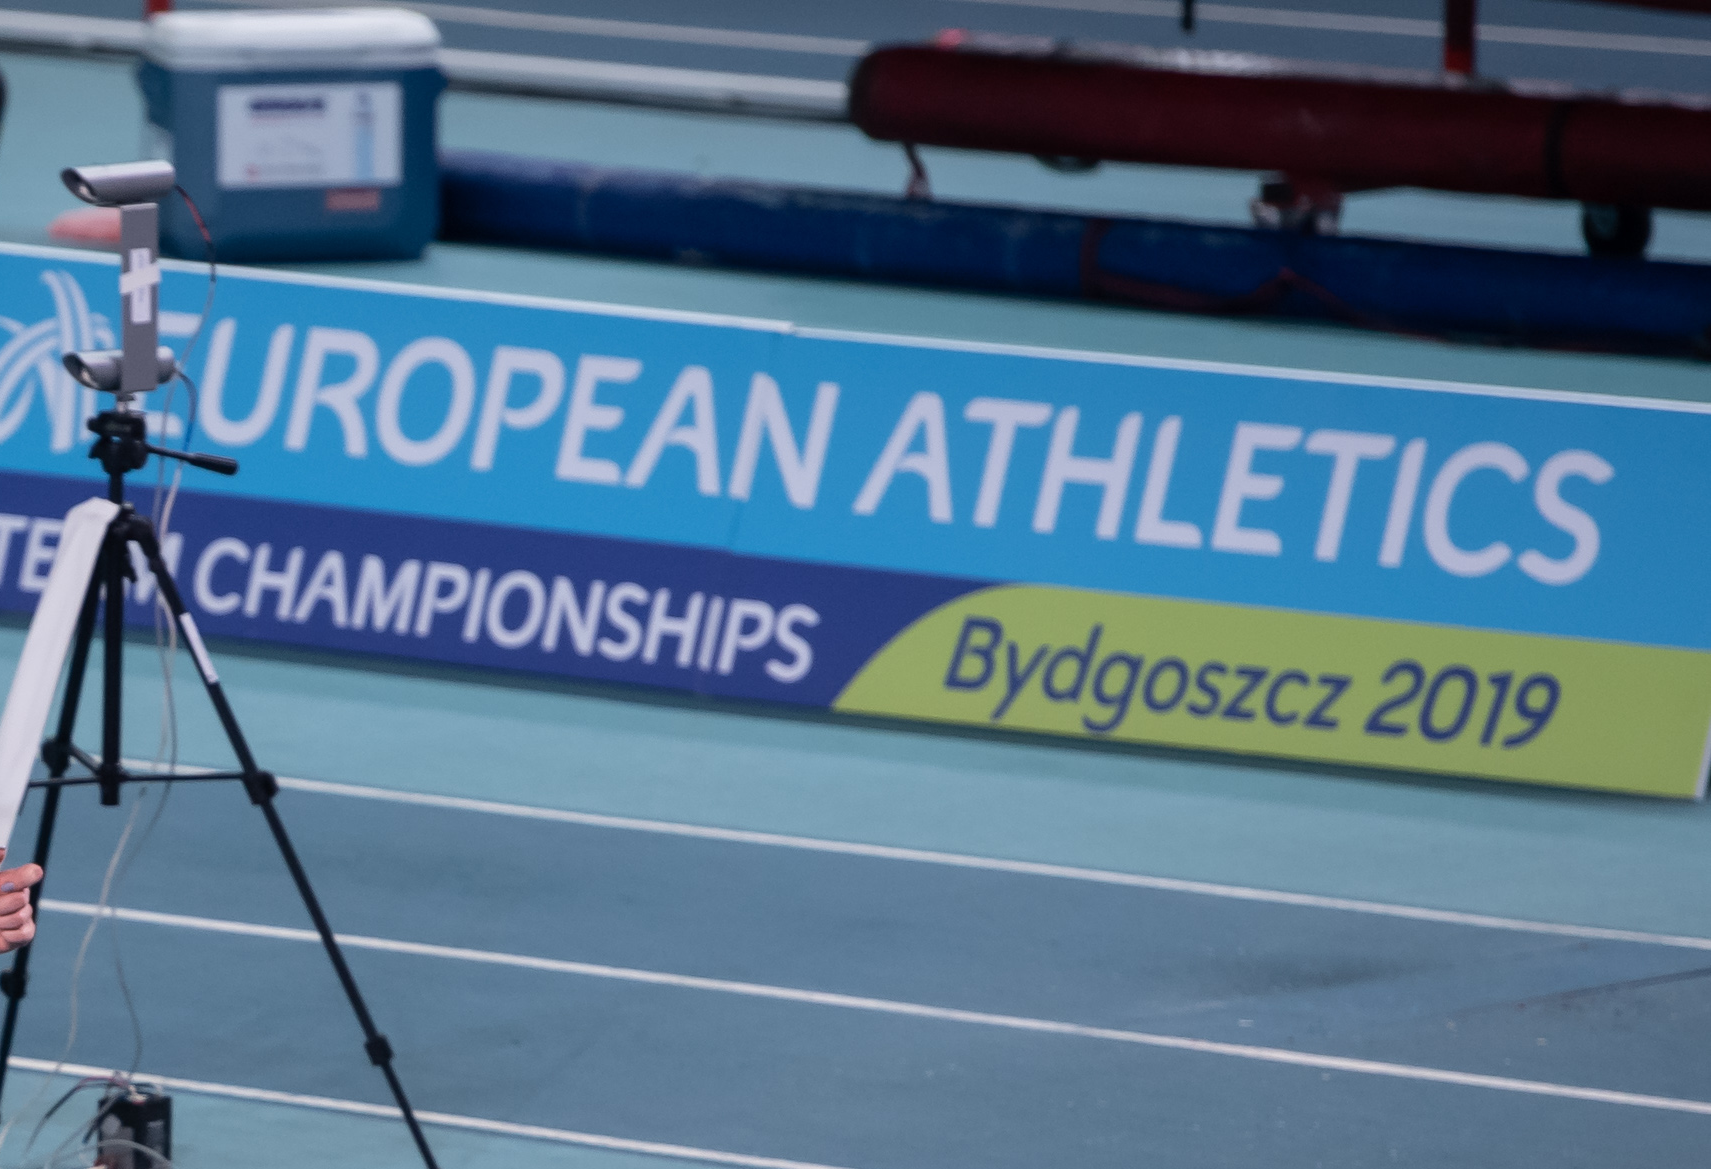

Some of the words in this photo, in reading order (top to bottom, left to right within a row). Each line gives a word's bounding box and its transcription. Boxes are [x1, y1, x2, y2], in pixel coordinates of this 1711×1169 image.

[851, 390, 1615, 588] ATHLETICS
[193, 537, 821, 684] CHAMPIONSHIPS
[943, 615, 1353, 735] Bydgoszcz
[1363, 658, 1563, 750] 2019
